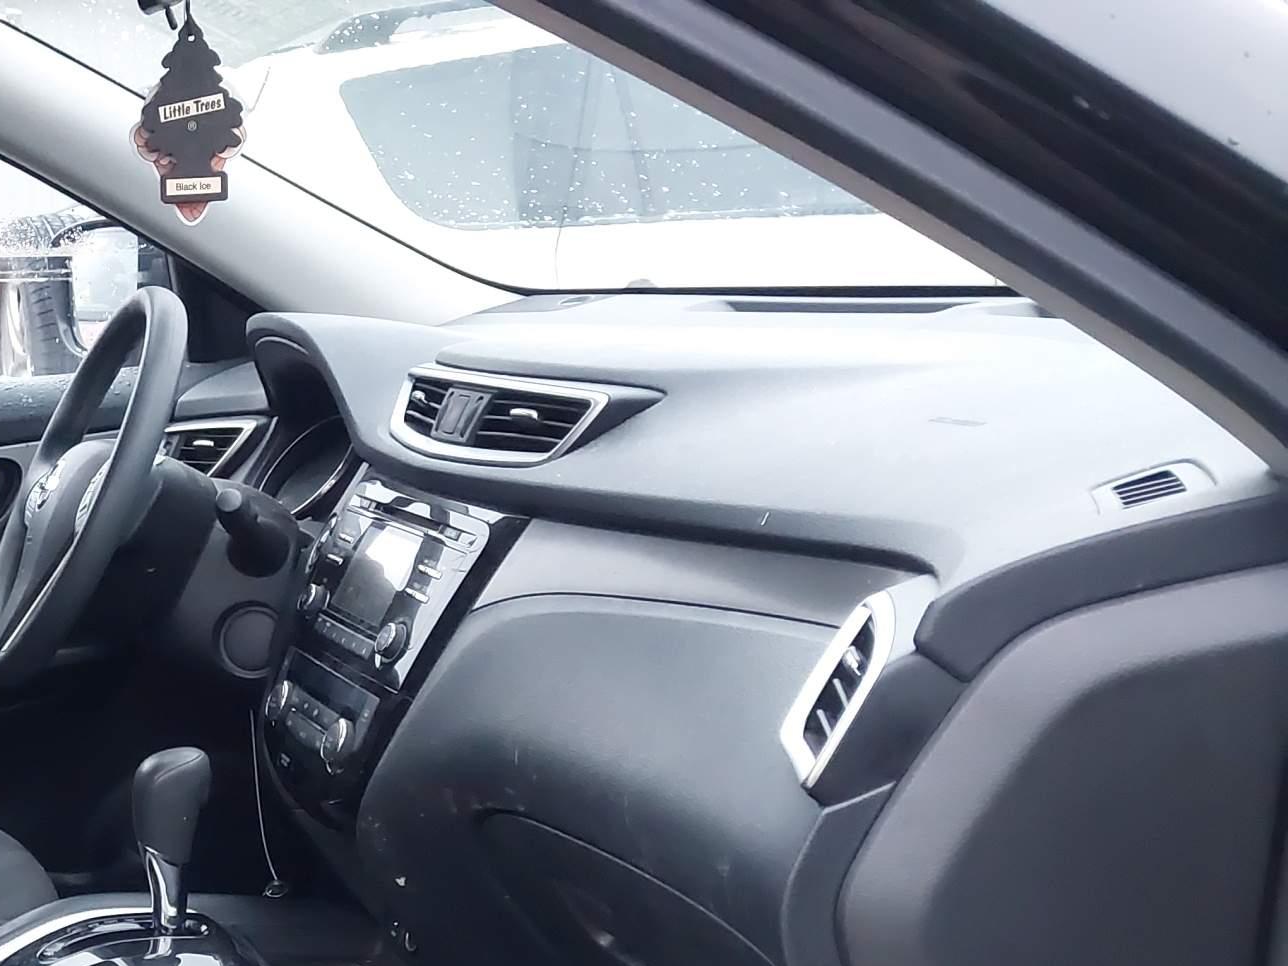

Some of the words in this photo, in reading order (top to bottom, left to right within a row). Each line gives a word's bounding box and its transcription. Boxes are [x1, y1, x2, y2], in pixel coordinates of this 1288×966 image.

[163, 104, 191, 120] Little
[193, 99, 222, 113] Trees
[175, 183, 198, 191] Black
[199, 182, 212, 191] Ice
